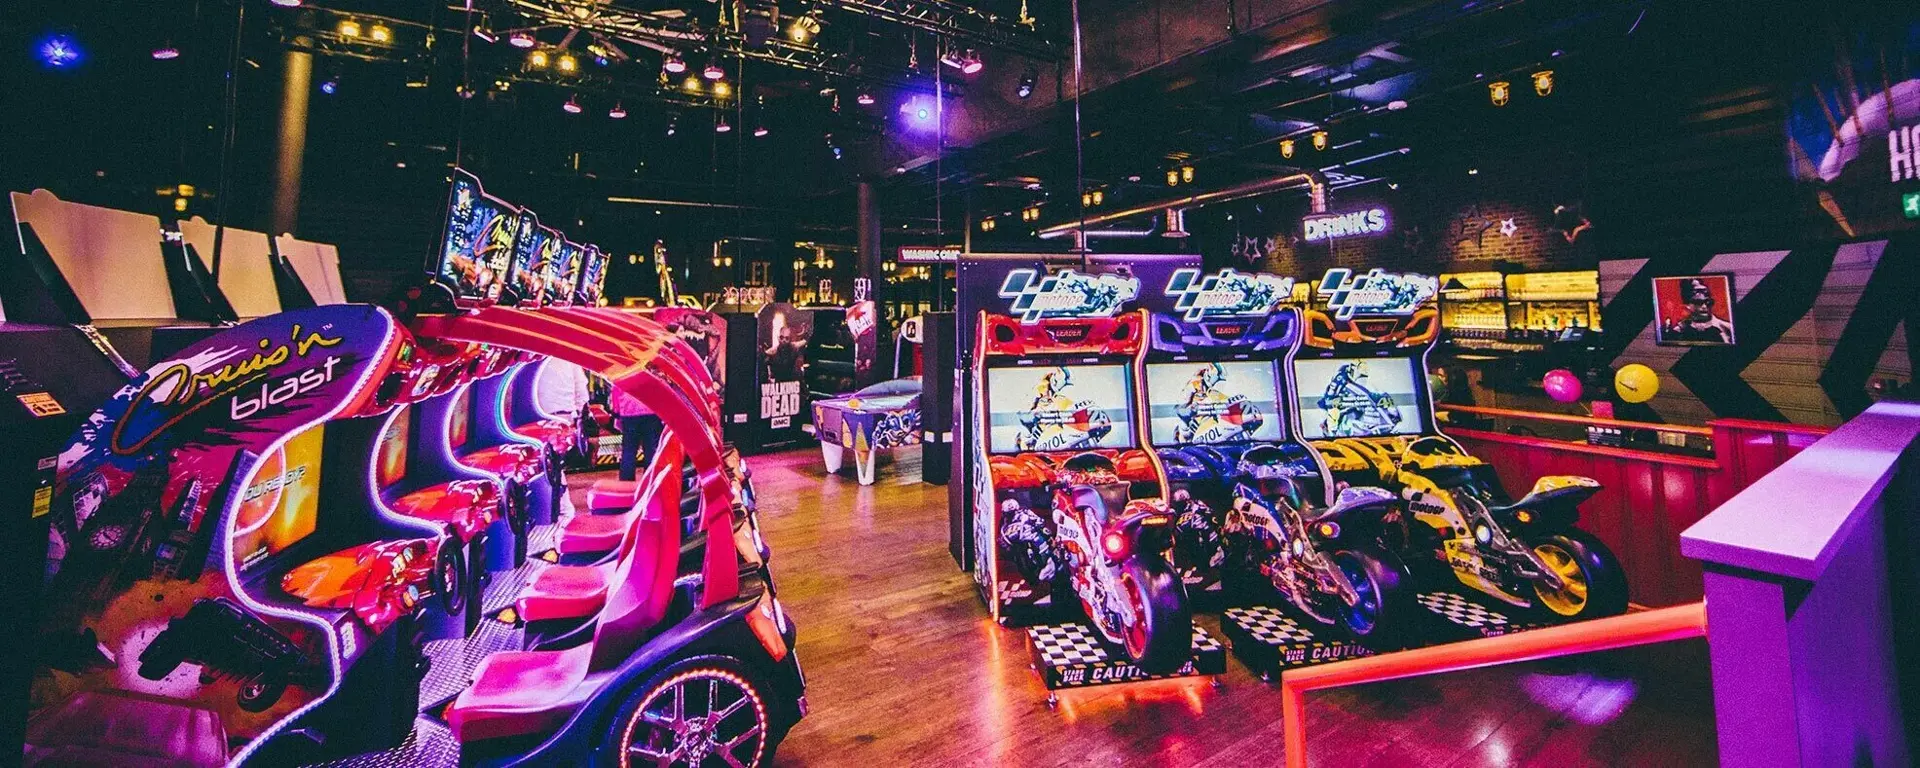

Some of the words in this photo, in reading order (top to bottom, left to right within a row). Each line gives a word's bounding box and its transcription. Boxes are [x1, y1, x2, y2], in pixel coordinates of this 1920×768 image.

[1304, 209, 1386, 240] DRINKS
[112, 325, 342, 456] Cruis'n
[231, 356, 341, 420] blast
[761, 381, 800, 396] WALKING
[761, 394, 800, 419] DEAD
[1063, 674, 1085, 682] BACK
